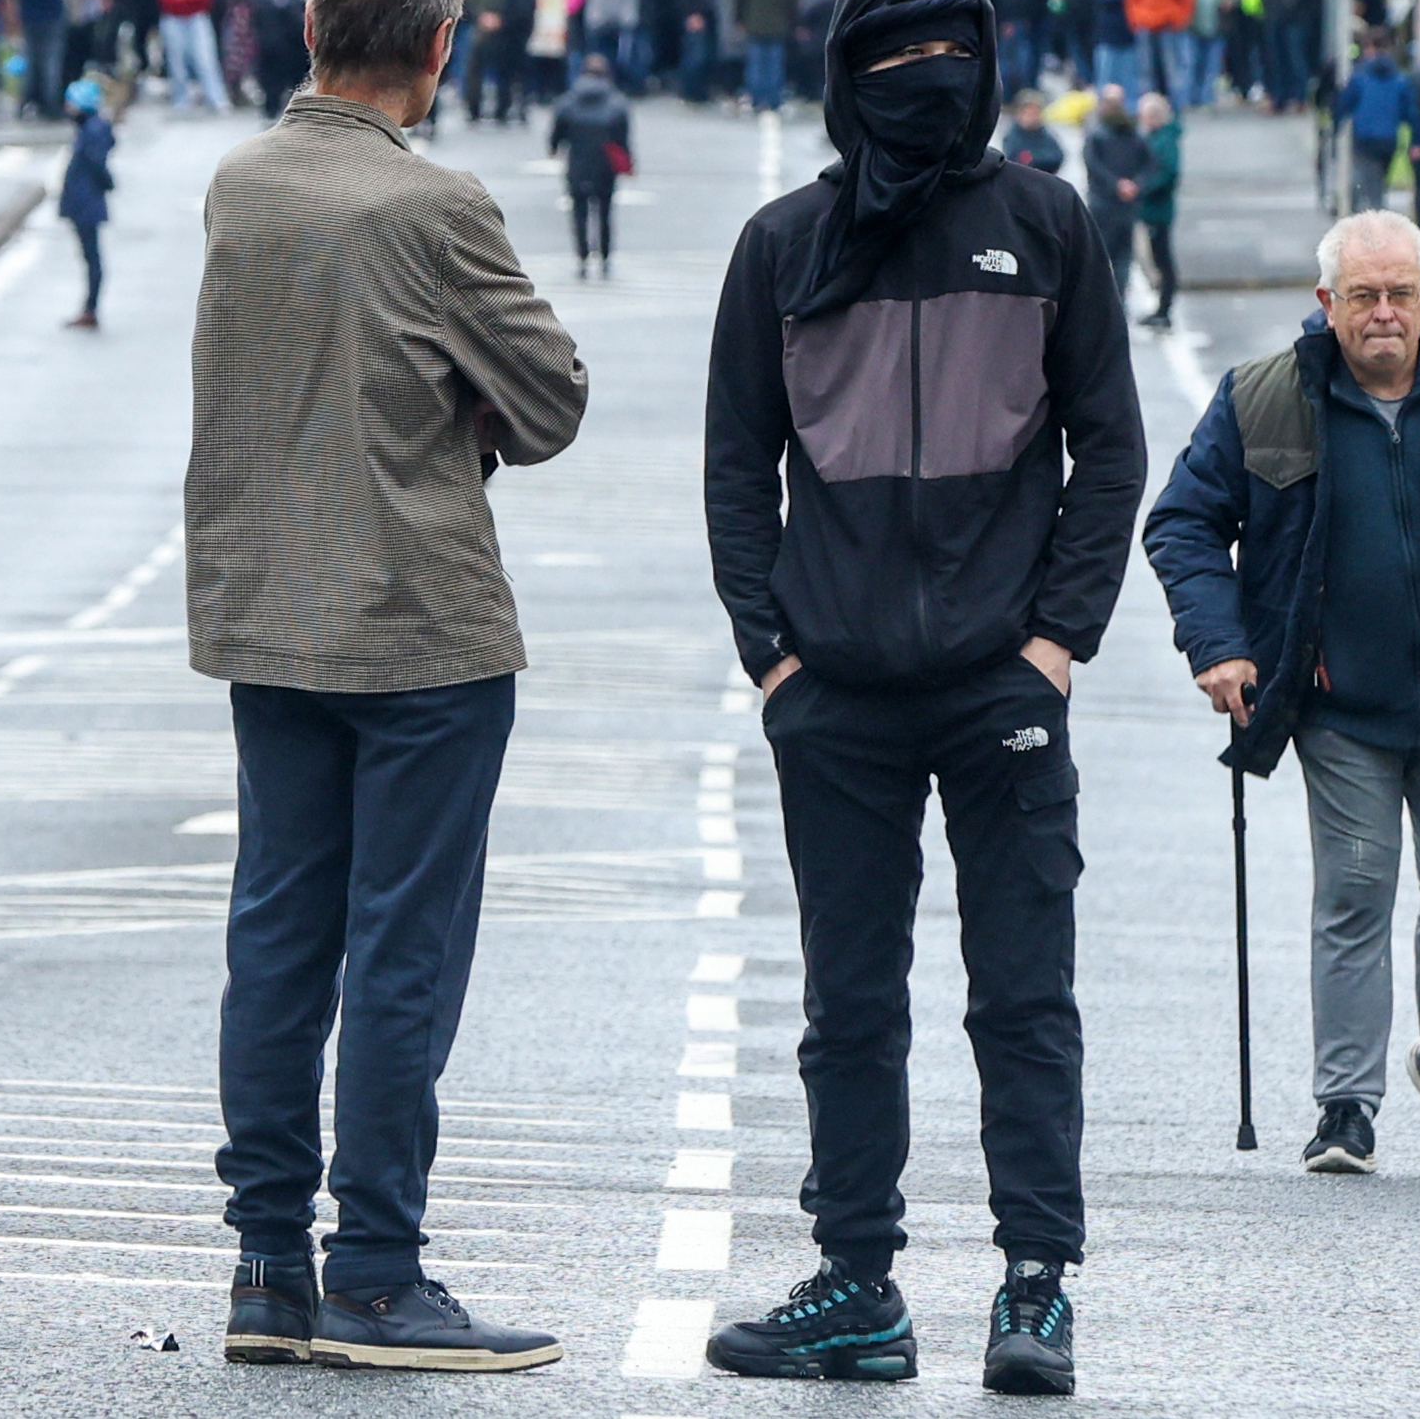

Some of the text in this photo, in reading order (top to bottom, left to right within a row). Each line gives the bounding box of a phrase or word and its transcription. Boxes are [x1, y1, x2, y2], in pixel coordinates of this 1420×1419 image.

[985, 249, 1003, 258] THE
[972, 254, 1003, 266] NORTH
[980, 262, 1002, 272] FACE
